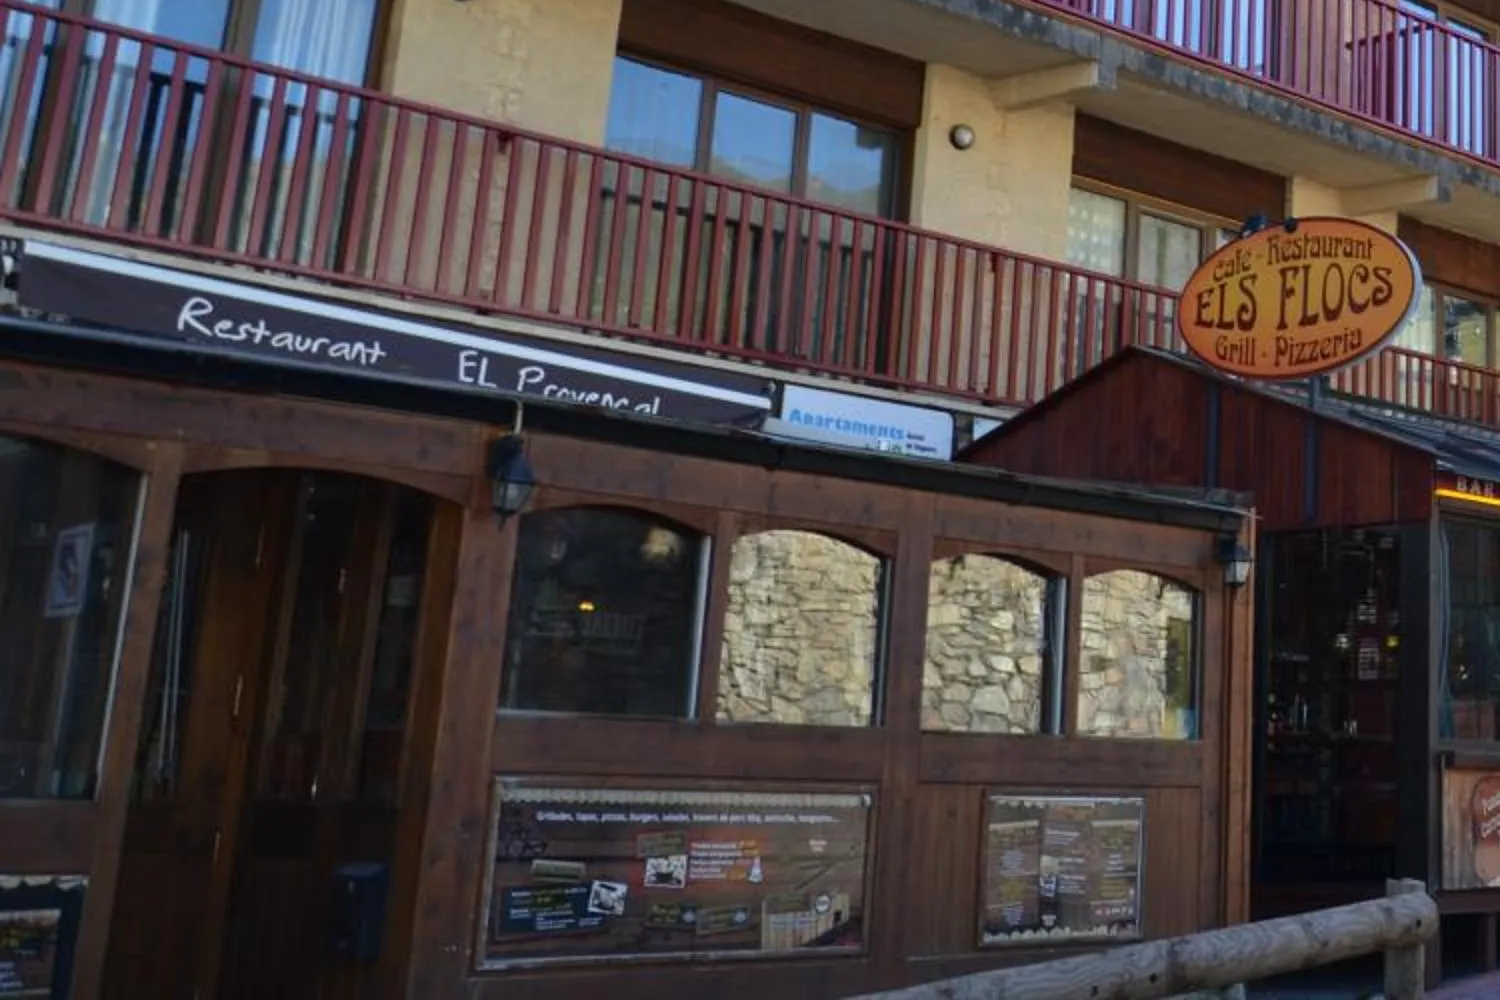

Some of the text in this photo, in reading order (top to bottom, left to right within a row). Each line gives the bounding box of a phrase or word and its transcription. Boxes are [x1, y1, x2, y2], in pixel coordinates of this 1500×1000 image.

[1267, 233, 1374, 265] Restaurant
[1194, 263, 1393, 331] ELS FLOCS
[177, 297, 387, 366] Restaurant
[1215, 328, 1364, 367] Grill Pizzeria
[788, 408, 905, 440] Apartaments
[1456, 475, 1495, 499] BAR
